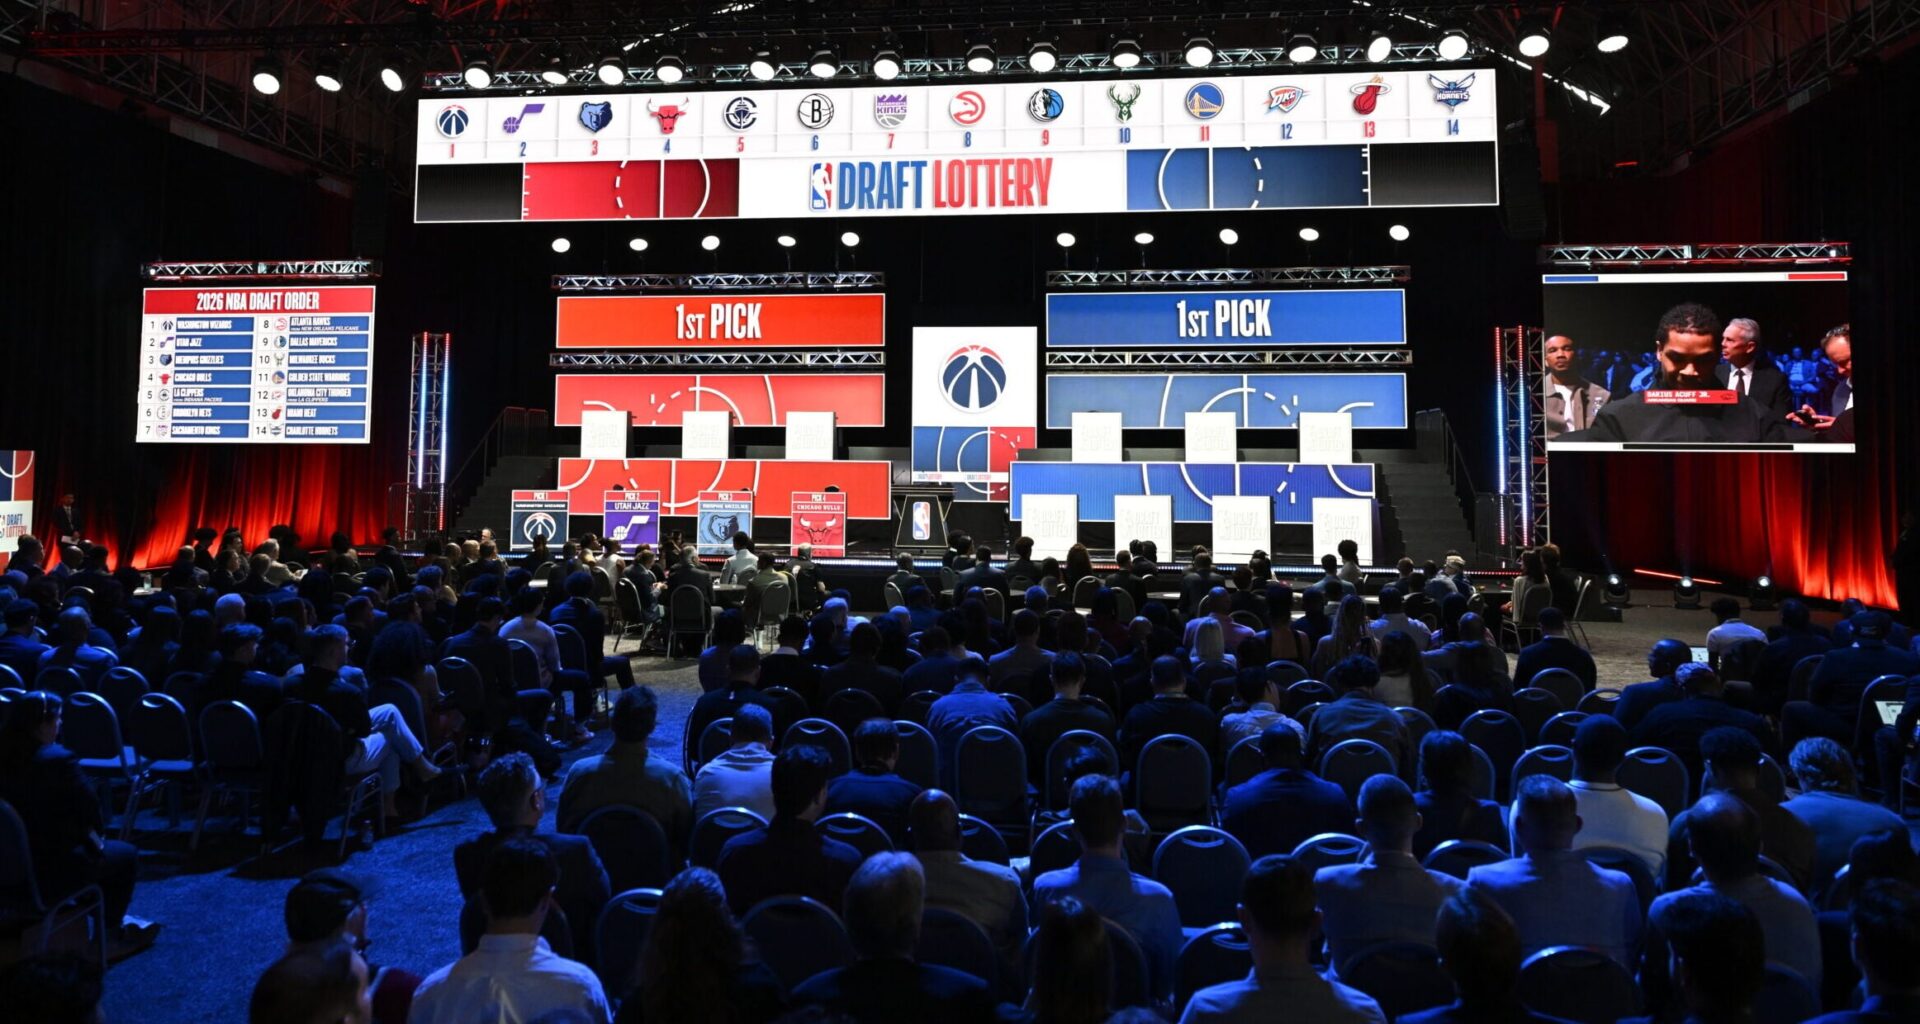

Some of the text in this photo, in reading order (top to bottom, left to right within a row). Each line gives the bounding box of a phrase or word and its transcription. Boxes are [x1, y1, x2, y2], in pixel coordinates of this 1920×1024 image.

[877, 106, 907, 114] KINGS
[450, 118, 1459, 158] 1 2 3 4 5 6 7 8 9 10 11 12 13 14
[838, 157, 1053, 210] DRAFT LOTTERY
[196, 291, 319, 311] 2026 NBA DRAFT ORDER
[676, 303, 762, 339] 1ST PICK
[1177, 299, 1272, 337] 1ST PICK
[150, 321, 155, 329] 1
[263, 320, 269, 329] 8
[150, 338, 155, 346] 2
[263, 338, 269, 346] 9
[149, 356, 154, 364] 3
[259, 355, 270, 364] 10
[148, 373, 153, 381] 4
[258, 373, 268, 381] 11
[147, 391, 153, 399] 5
[257, 391, 269, 400] 12
[146, 408, 152, 417] 6
[257, 408, 268, 417] 13
[145, 426, 151, 434] 7
[256, 426, 267, 435] 14
[533, 492, 545, 500] PICK
[624, 492, 636, 501] PICK
[718, 493, 729, 501] PICK
[811, 494, 822, 502] PICK
[614, 502, 650, 510] UTAH JAZZ
[7, 514, 23, 526] DRAFT
[6, 525, 27, 538] LOTTERY
